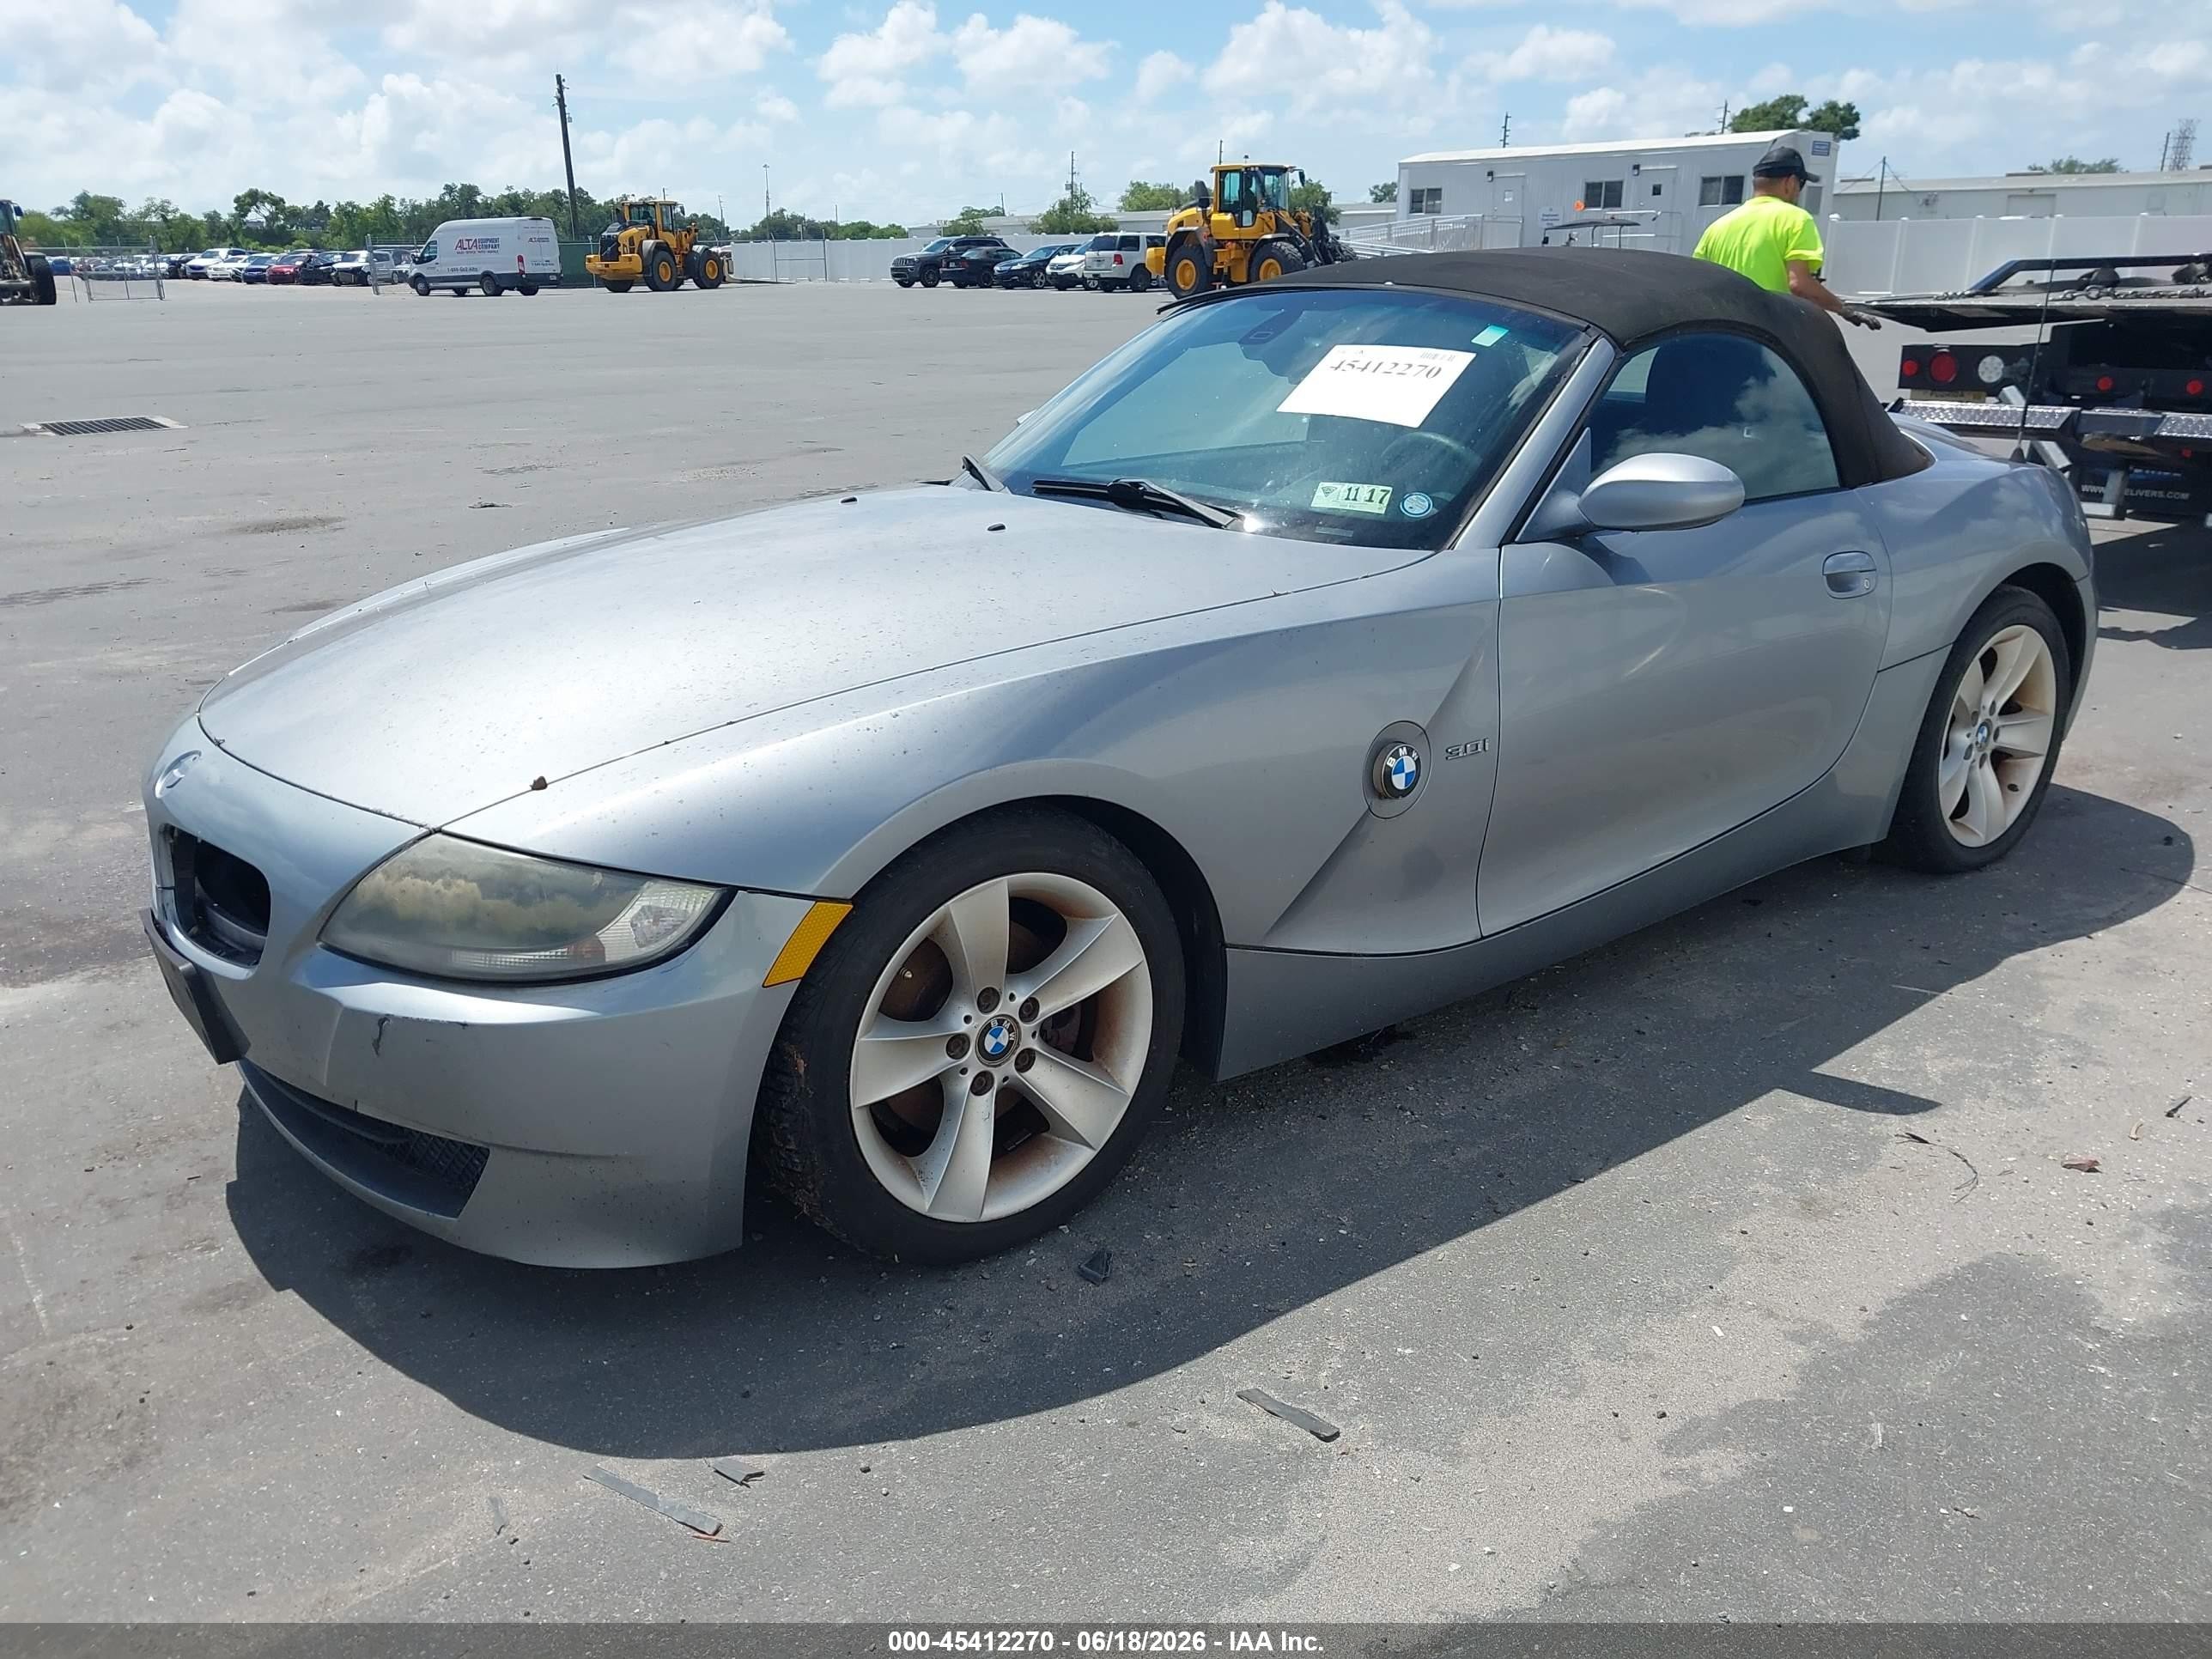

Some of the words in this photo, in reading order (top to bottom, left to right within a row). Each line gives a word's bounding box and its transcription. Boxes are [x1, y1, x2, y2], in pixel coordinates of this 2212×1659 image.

[455, 238, 478, 250] ALTA
[1330, 359, 1442, 379] 45412270
[1344, 486, 1360, 501] 11
[1364, 489, 1391, 505] 17
[1386, 746, 1419, 768] BMW
[990, 1018, 1016, 1041] BMW
